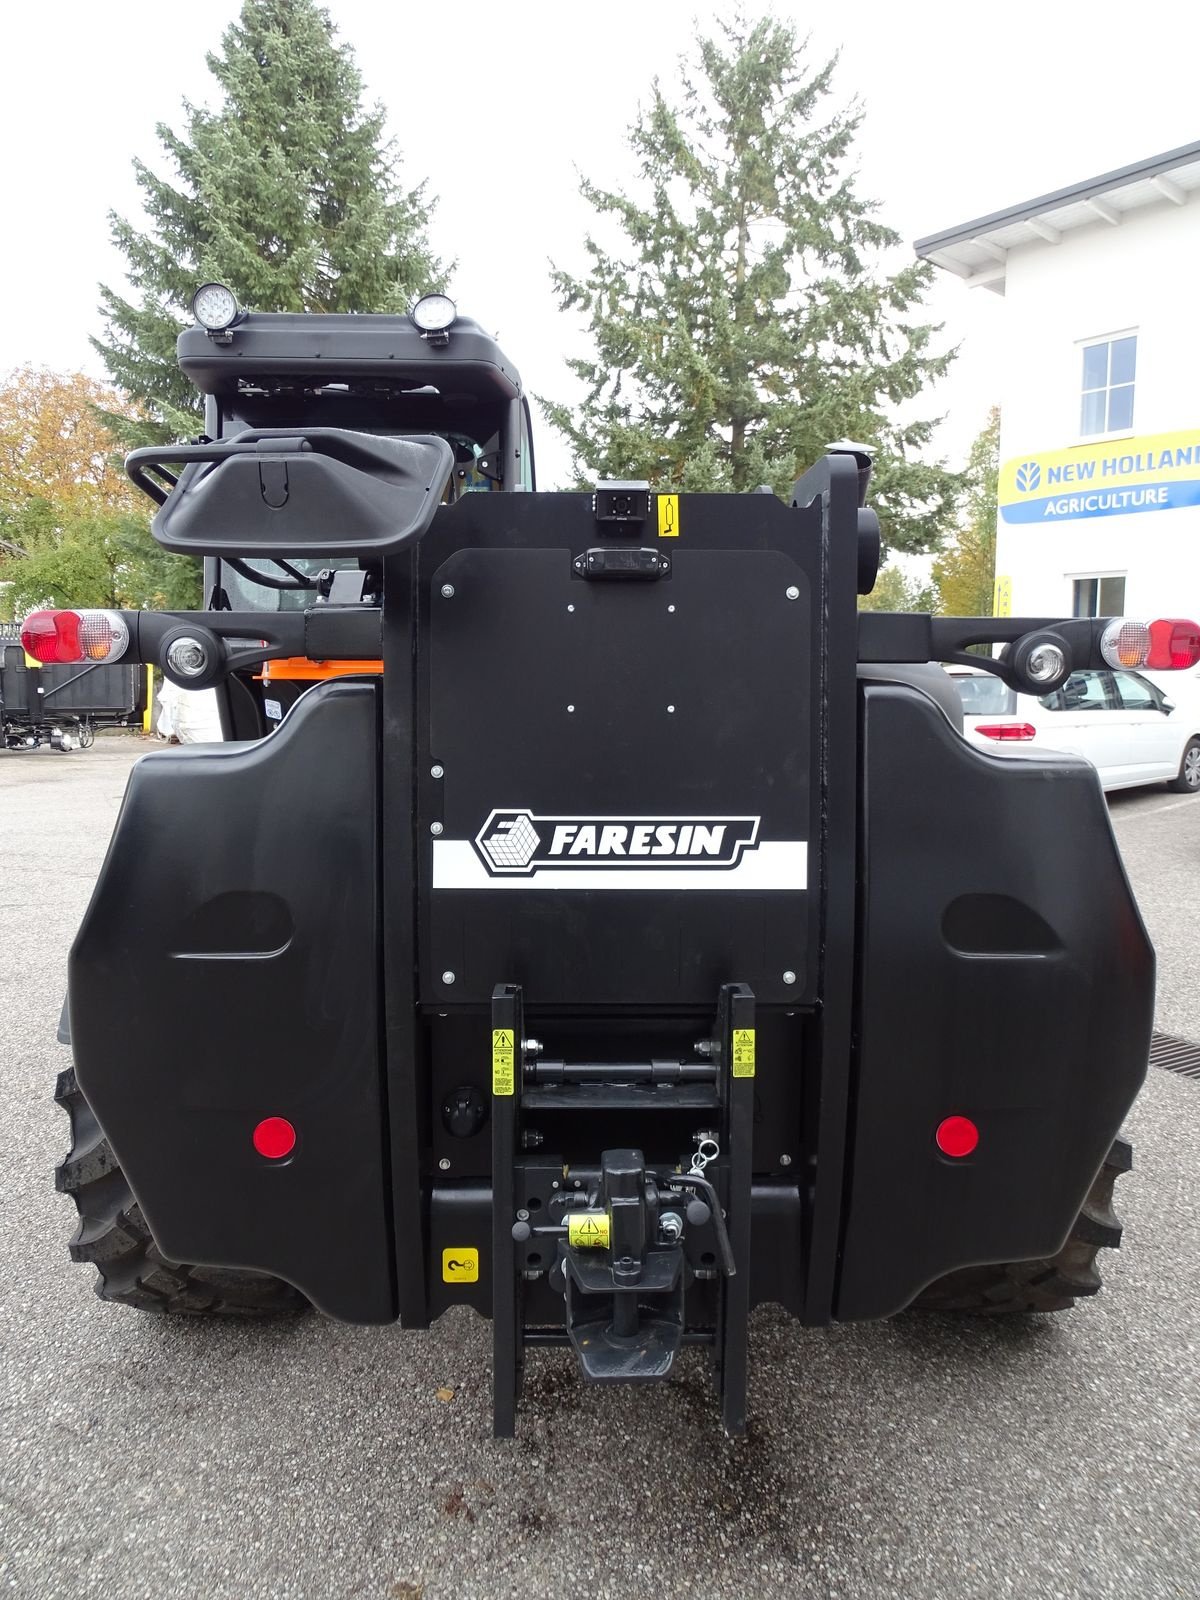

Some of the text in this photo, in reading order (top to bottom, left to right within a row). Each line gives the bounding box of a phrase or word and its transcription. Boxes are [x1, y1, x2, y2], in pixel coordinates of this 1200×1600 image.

[1047, 461, 1096, 484] NEW
[1044, 487, 1169, 517] AGRICULTURE
[548, 825, 728, 856] FARESIN
